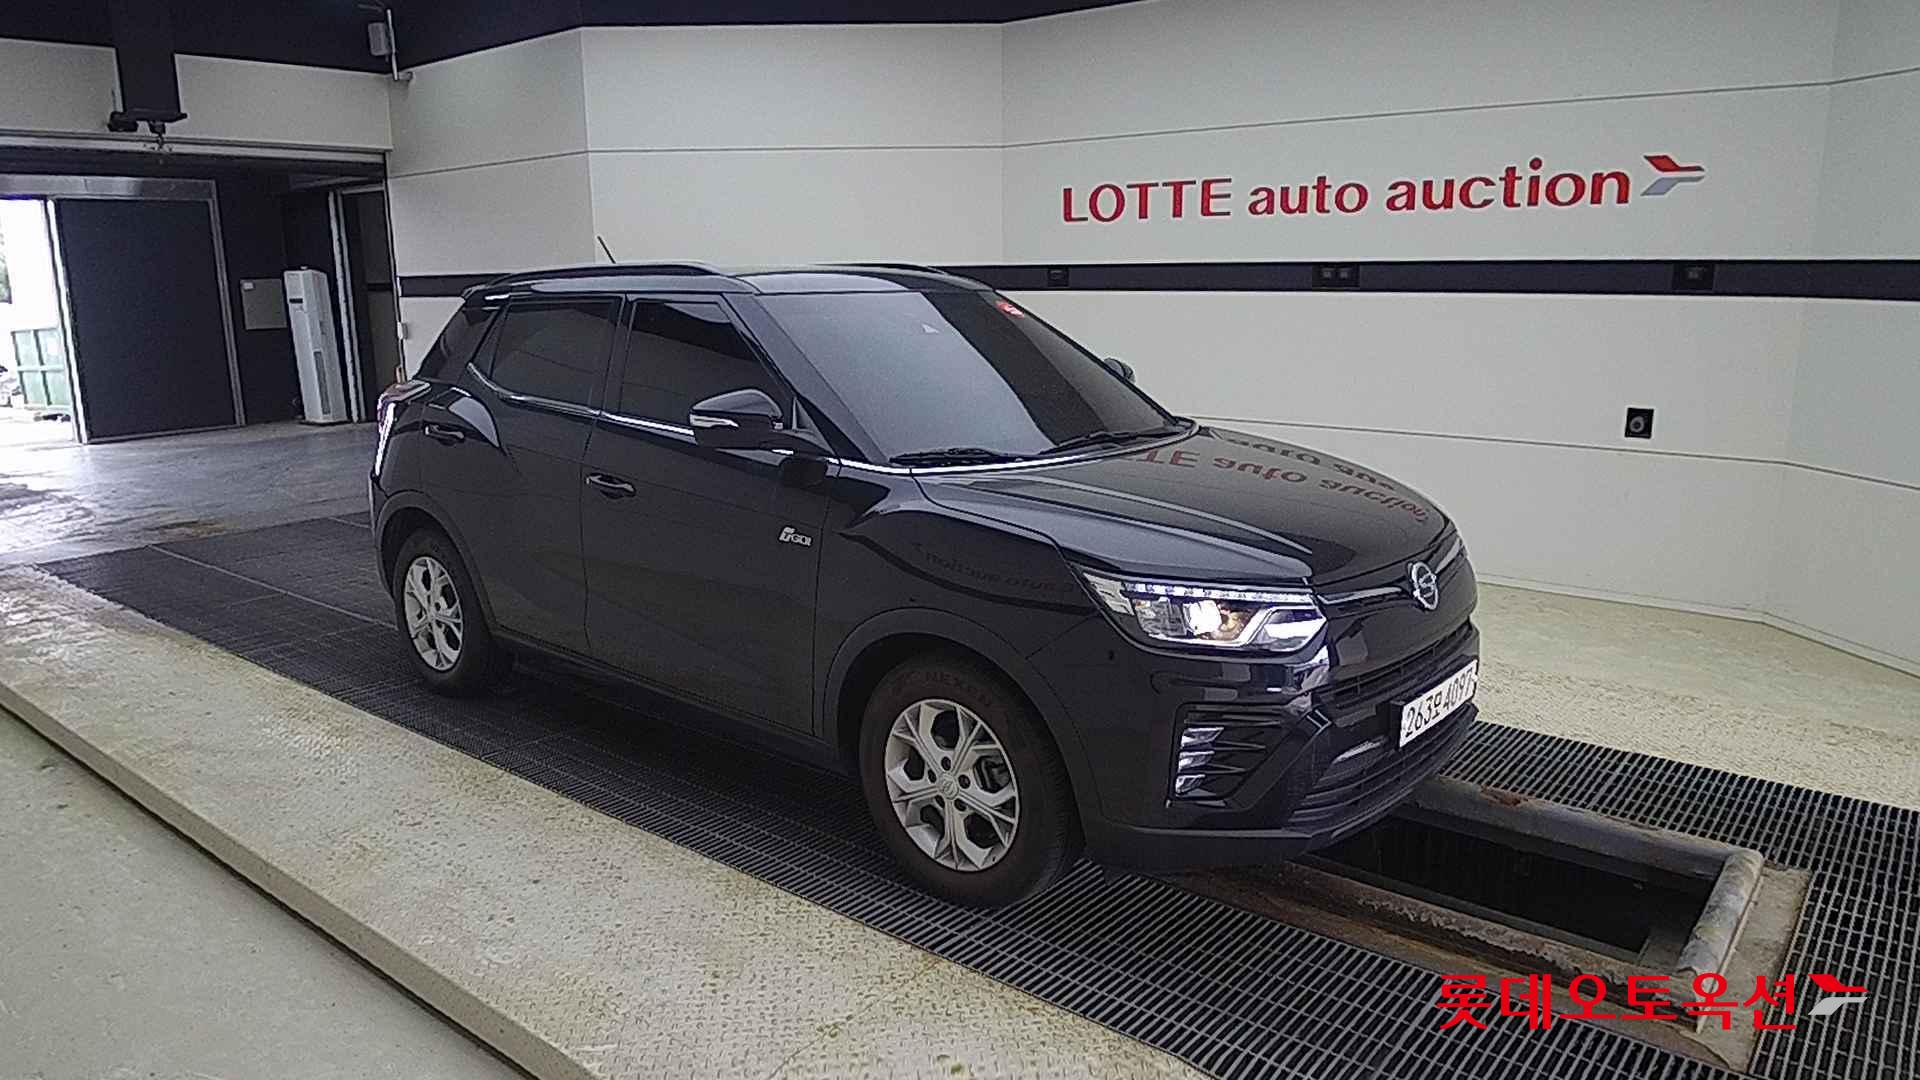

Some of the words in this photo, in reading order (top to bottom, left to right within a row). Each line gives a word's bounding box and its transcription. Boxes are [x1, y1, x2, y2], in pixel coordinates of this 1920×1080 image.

[1061, 178, 1233, 223] LOTTE
[1247, 176, 1369, 216] auto
[1385, 157, 1631, 212] auction
